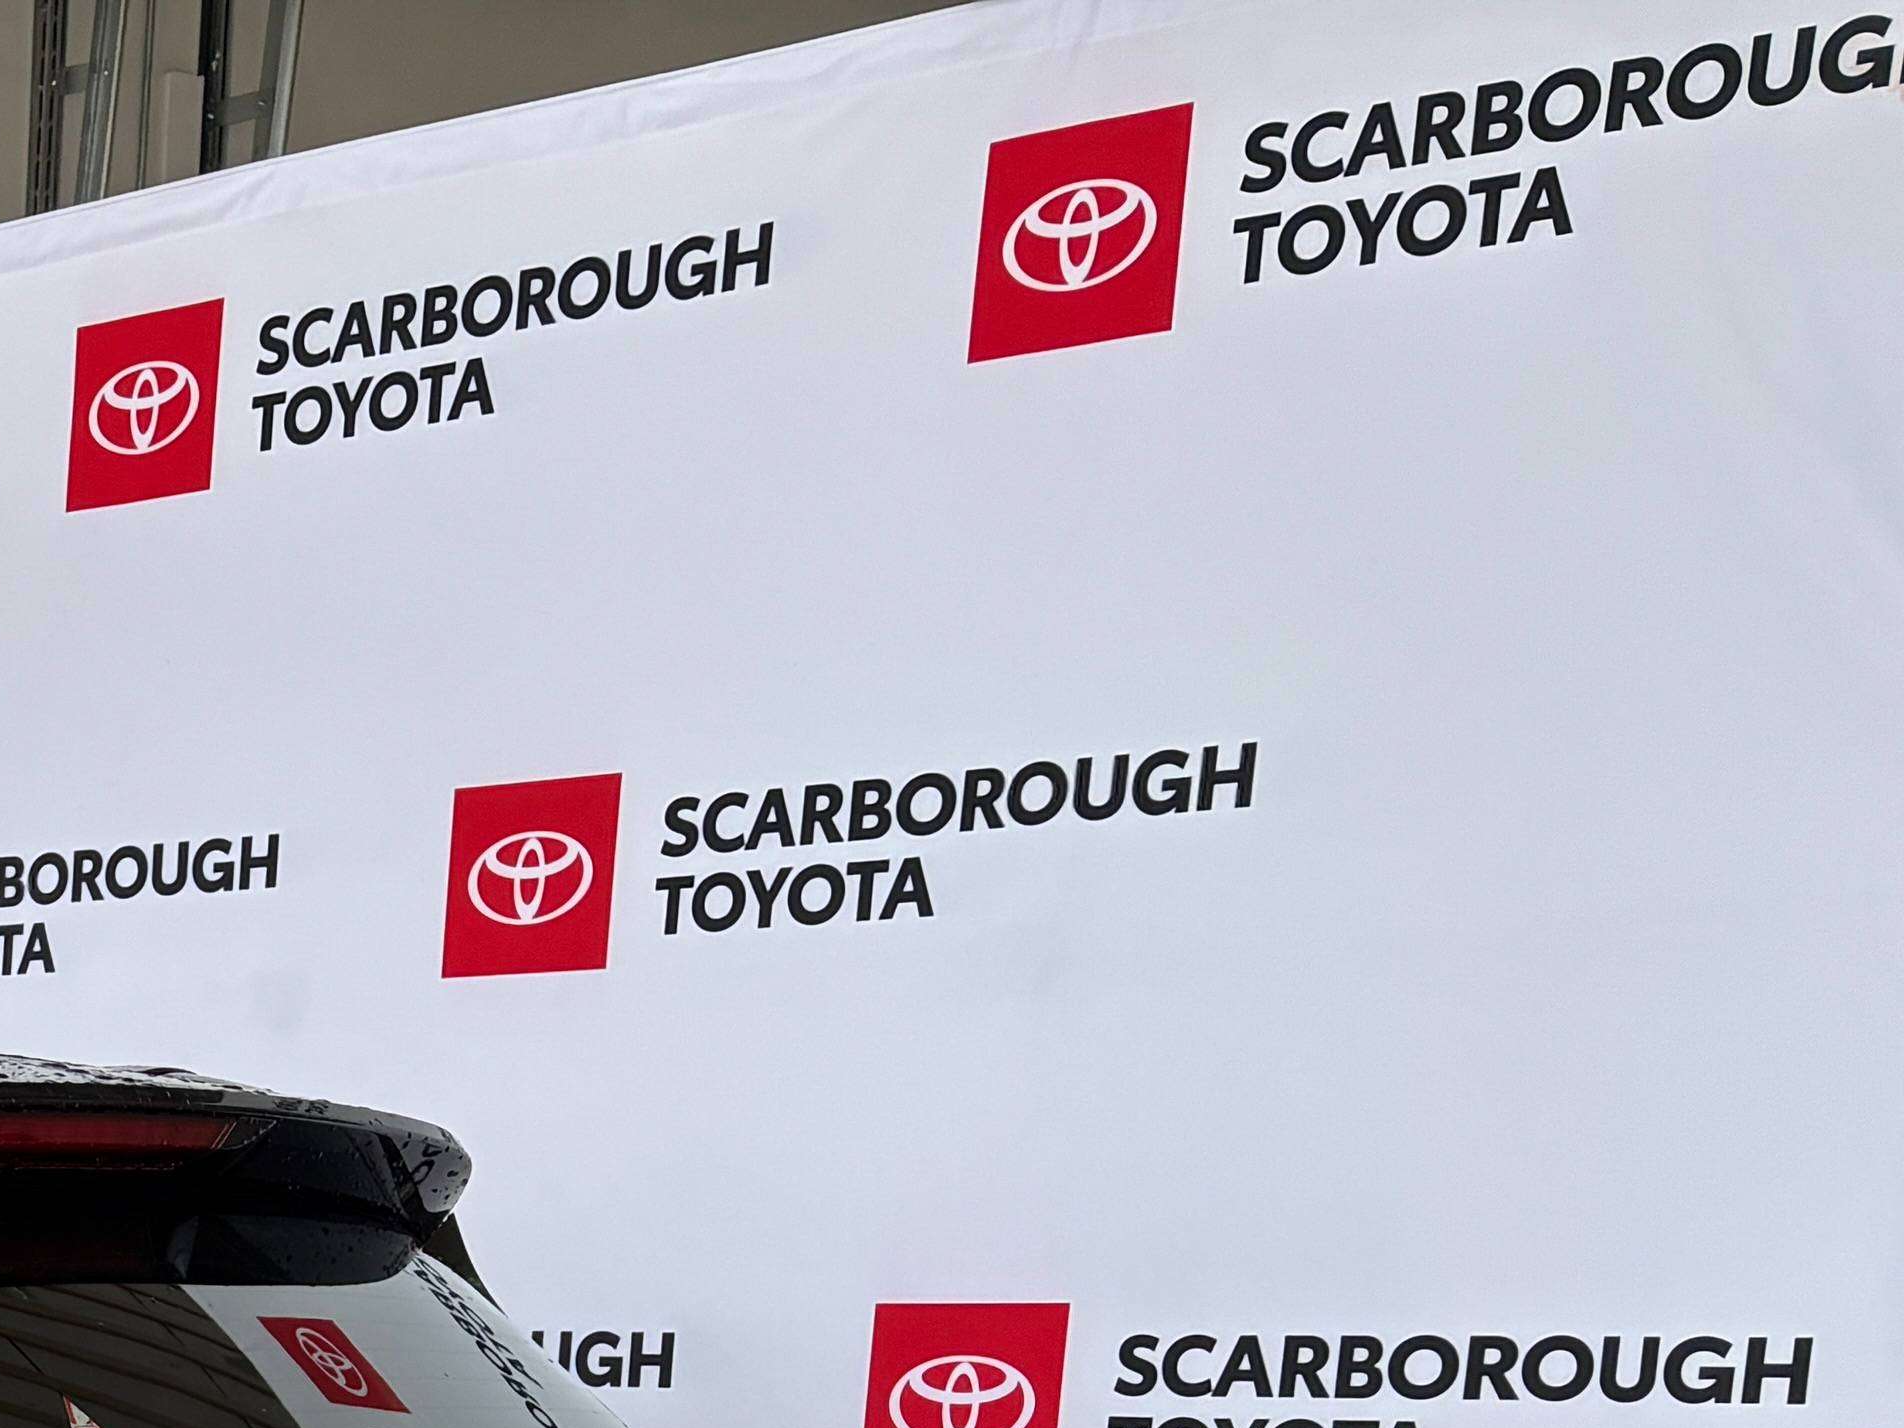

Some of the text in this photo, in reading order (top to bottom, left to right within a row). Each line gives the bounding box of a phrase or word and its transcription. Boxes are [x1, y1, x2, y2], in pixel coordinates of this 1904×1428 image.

[1240, 14, 1904, 193] SCARBOROUG
[1234, 167, 1572, 283] TOYOTA
[256, 221, 774, 376] SCARBOROUGH
[253, 357, 494, 451] TOYOTA
[661, 741, 1258, 857] SCARBOROUGH
[655, 857, 933, 935] TOYOTA
[1115, 1334, 1813, 1405] SCARBOROUGH
